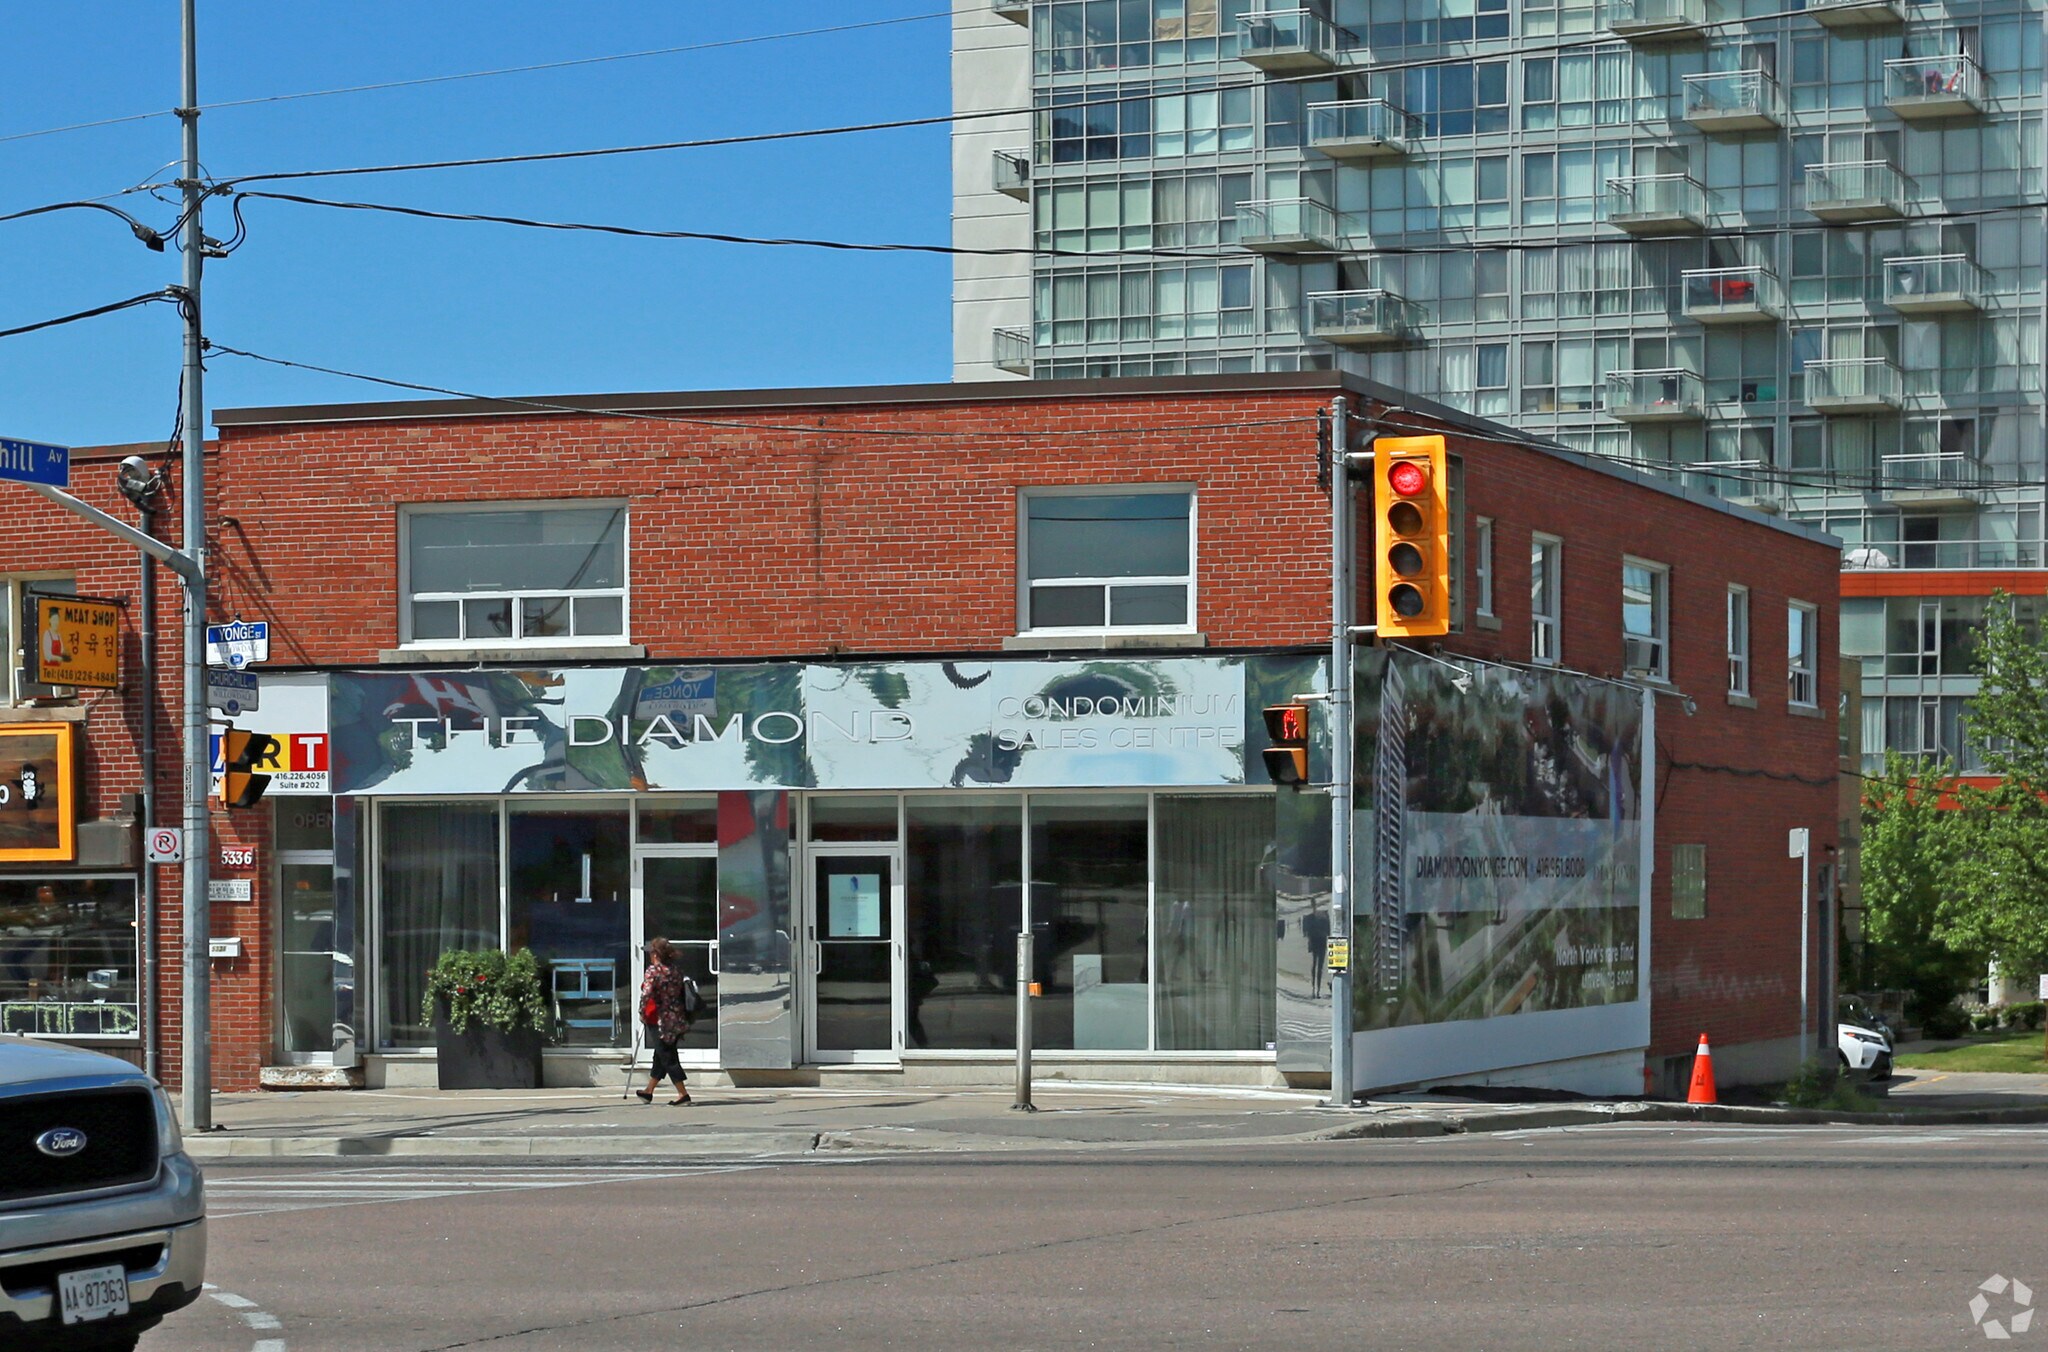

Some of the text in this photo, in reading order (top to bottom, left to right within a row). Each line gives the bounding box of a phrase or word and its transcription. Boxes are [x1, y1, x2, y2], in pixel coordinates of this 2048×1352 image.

[47, 448, 62, 463] Av
[65, 607, 115, 627] MEAT SHOP
[218, 626, 255, 641] YONGE
[69, 631, 114, 657] 정육점
[997, 694, 1237, 719] CONDOMINIUM
[391, 709, 914, 749] THE DIAMOND
[998, 726, 1238, 750] SALES CENTRE
[274, 772, 326, 780] 416.226.4056
[279, 781, 320, 789] Suite #202
[221, 850, 253, 865] 5336
[1416, 856, 1528, 878] DIAMONDONYONGE.COM
[1556, 944, 1578, 966] North
[1580, 943, 1604, 965] York's
[1621, 940, 1635, 961] find
[1617, 969, 1634, 986] soon
[52, 1131, 78, 1150] Ford
